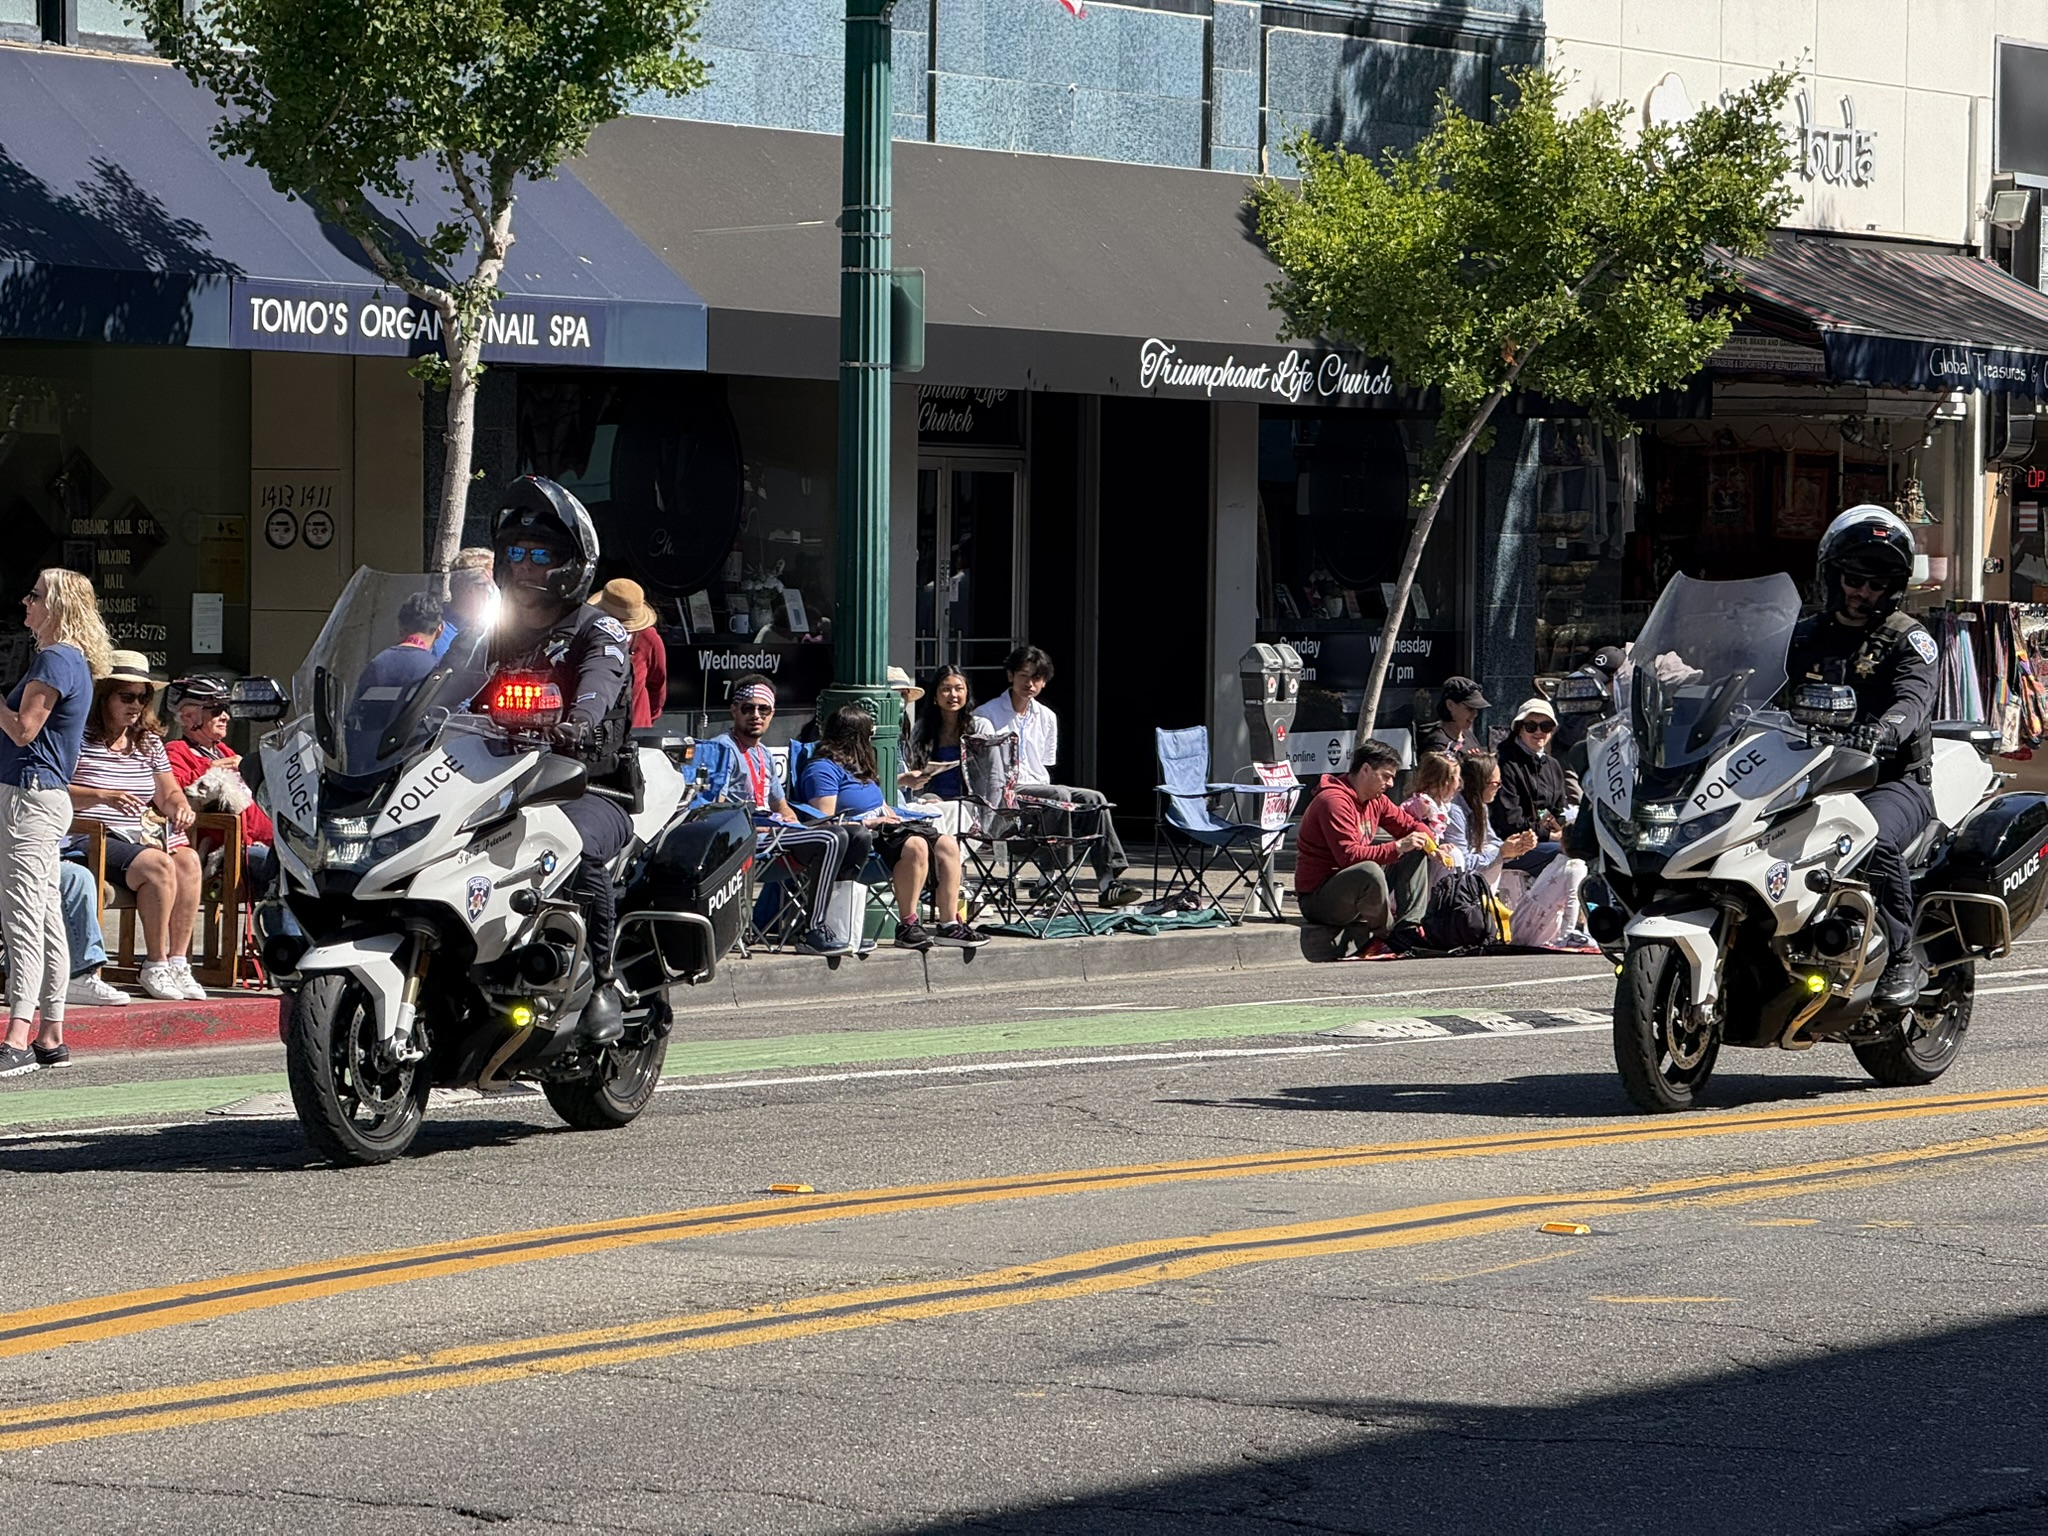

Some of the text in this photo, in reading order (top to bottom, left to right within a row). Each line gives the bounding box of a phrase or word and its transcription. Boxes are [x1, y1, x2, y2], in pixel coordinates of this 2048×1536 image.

[250, 298, 590, 348] TOMO'S ORGAN NAIL SPA
[1141, 338, 1392, 402] Triumphant Life Church
[1930, 348, 1970, 376] Global
[1972, 352, 2026, 381] Treasures
[918, 402, 974, 432] Church
[261, 484, 332, 508] 1413 1411
[71, 519, 155, 535] ORGANIC NAIL SPA
[97, 549, 131, 565] WAXING
[103, 574, 124, 589] NAIL
[699, 650, 781, 674] Wednesday
[1369, 636, 1432, 658] Wnesday
[722, 680, 731, 700] 7
[1397, 666, 1414, 684] pm
[285, 752, 312, 821] POLICE
[1606, 742, 1626, 805] POLICE
[1693, 749, 1767, 811] POLICE
[386, 755, 464, 825] POLICE
[2003, 852, 2040, 896] POLICE
[708, 868, 743, 916] POLICE
